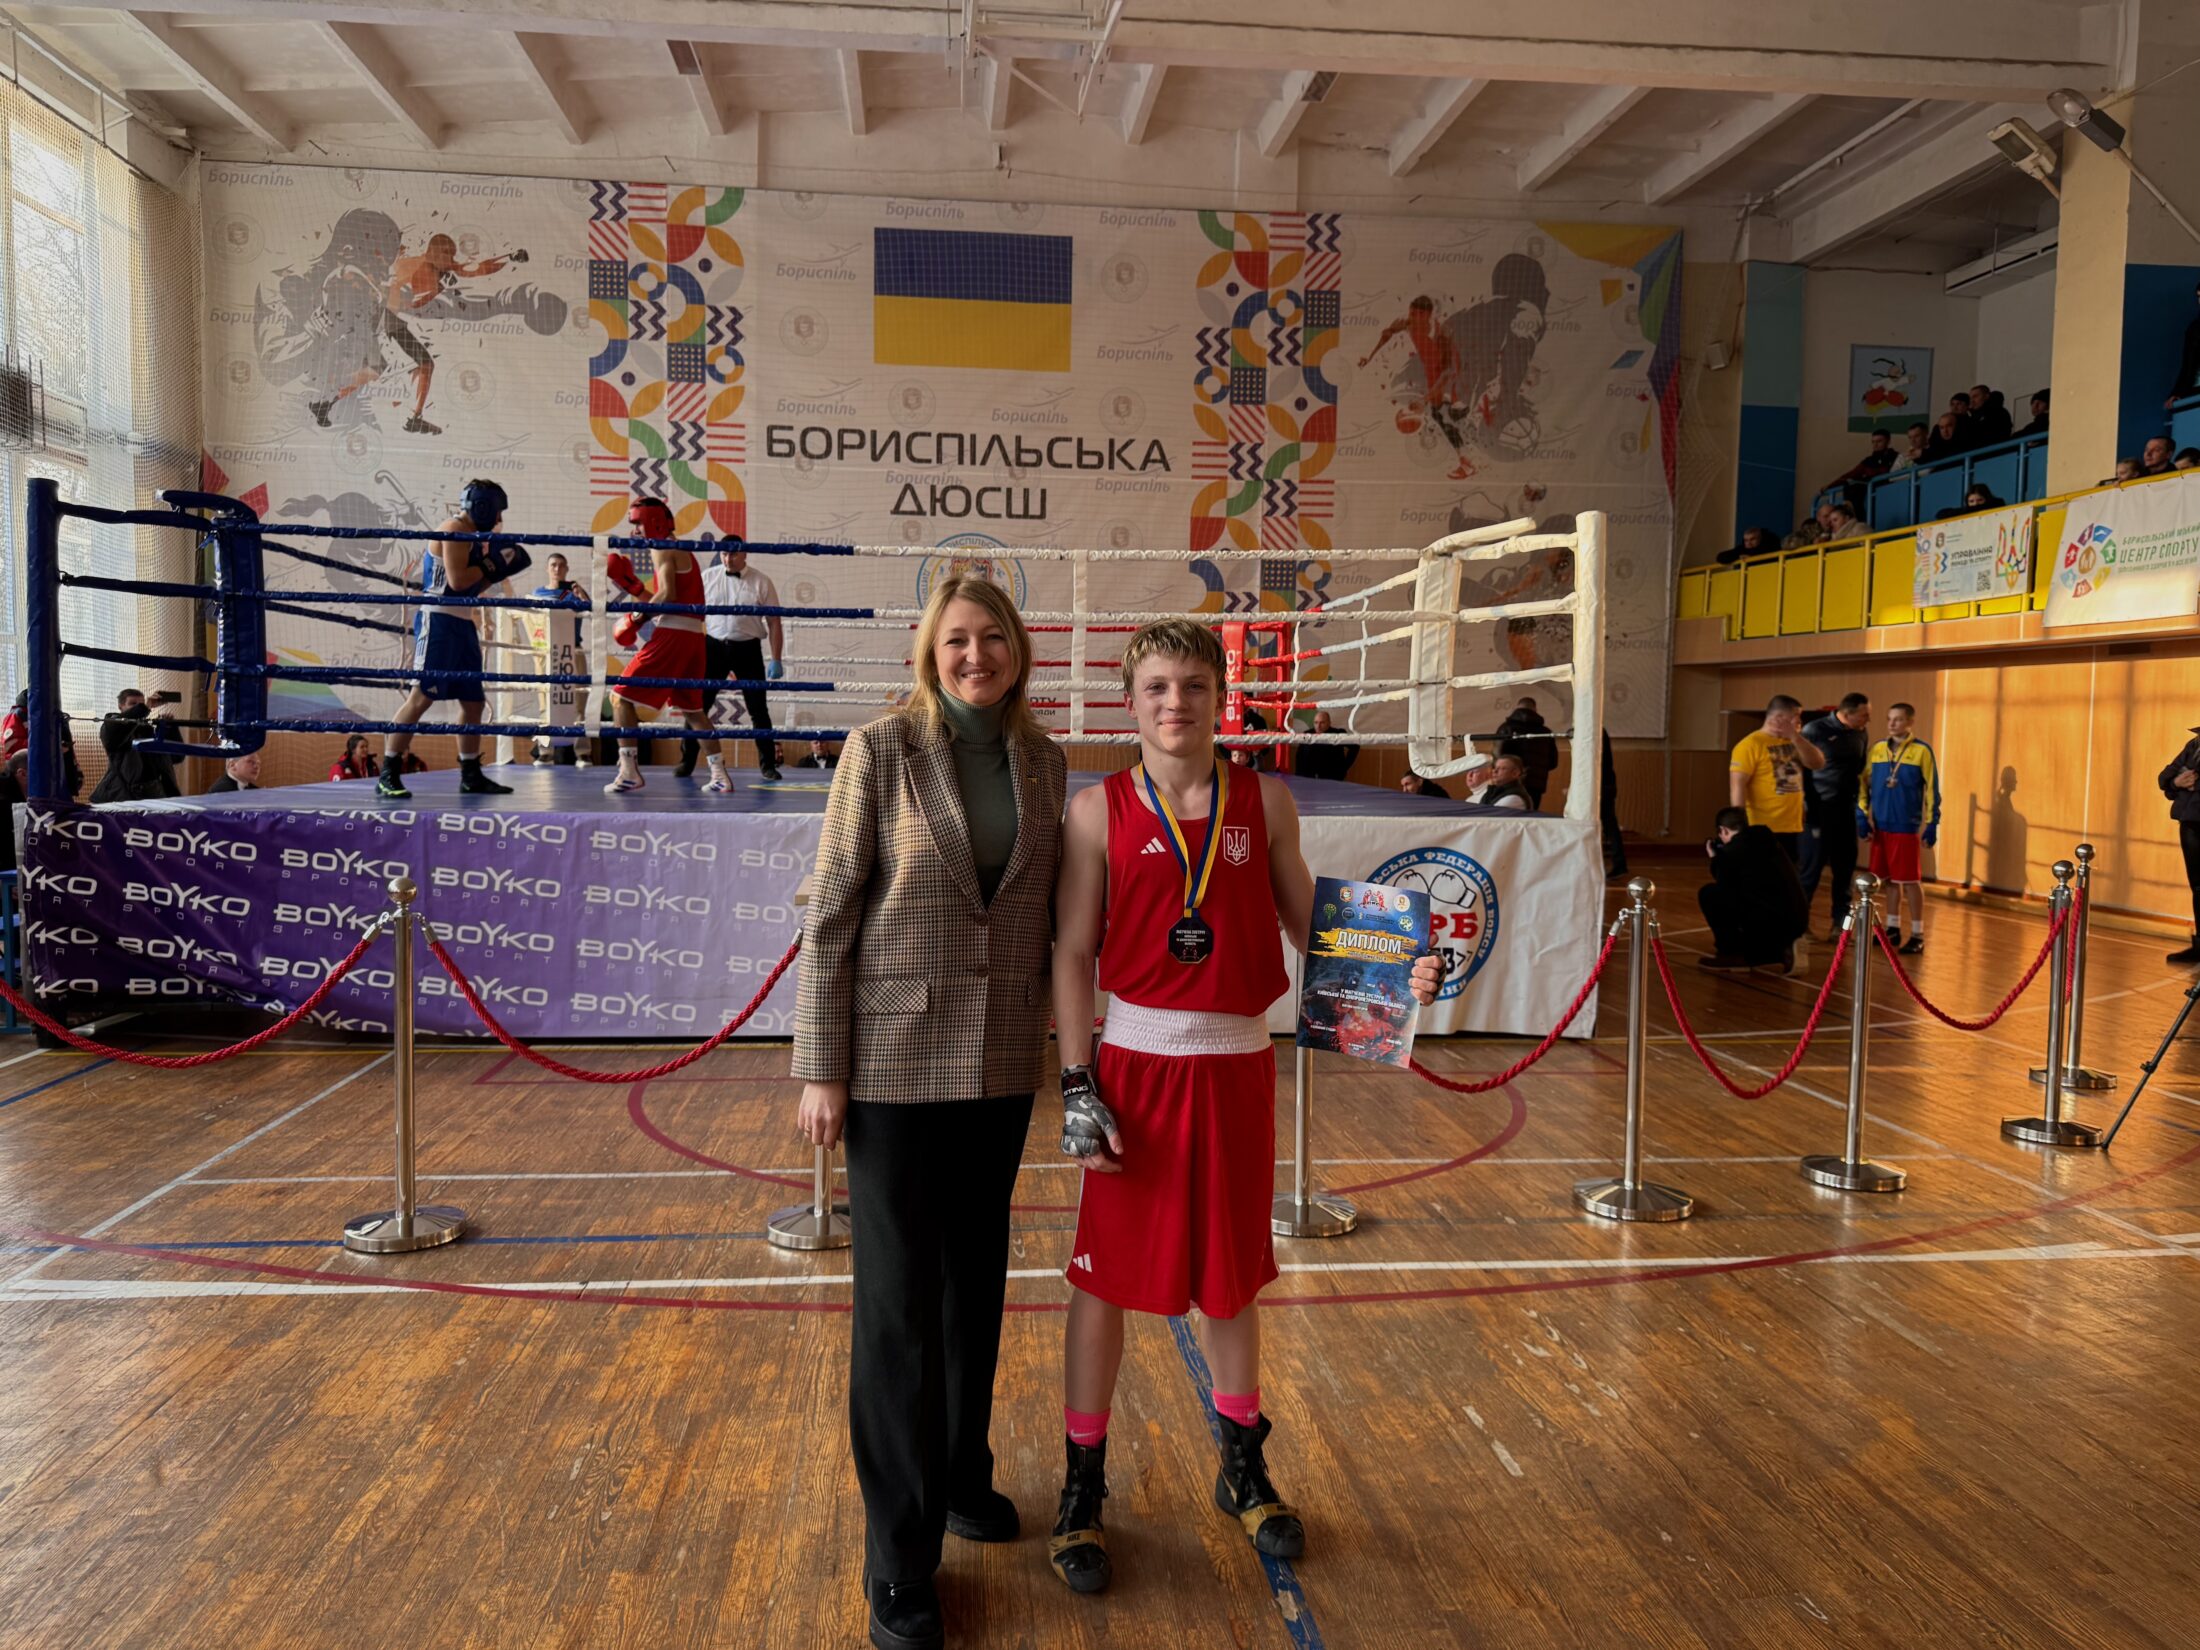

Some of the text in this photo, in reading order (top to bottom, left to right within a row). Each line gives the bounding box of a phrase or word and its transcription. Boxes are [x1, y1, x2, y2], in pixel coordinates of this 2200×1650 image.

[208, 169, 294, 187] Бориспіль
[440, 180, 523, 198] Бориспіль
[886, 202, 964, 220] Бориспіль
[1100, 210, 1176, 229] Бориспіль
[1409, 248, 1483, 265] Бориспіль
[777, 263, 856, 281] Бориспіль
[1097, 346, 1173, 362] Бориспіль
[777, 398, 856, 417] Бориспіль
[992, 407, 1068, 424] Бориспіль
[212, 447, 297, 463] Бориспіль
[766, 424, 1171, 472] БОРИСПІЛЬСЬКА
[443, 454, 525, 471] Бориспіль
[1095, 478, 1171, 494] Бориспіль
[890, 482, 1047, 520] ДЮСШ
[2119, 537, 2199, 564] ЦЕНТР СПОРТУ
[1225, 649, 1236, 721] BOKO
[437, 813, 567, 844] BOYKO
[123, 828, 257, 861] BOYKO
[589, 829, 717, 861] BOYKO
[280, 848, 409, 879] BOYKO
[739, 848, 815, 871] BOY
[282, 870, 377, 889] SPOR
[431, 866, 561, 898] BOYKO
[123, 882, 250, 916] BOYKO
[583, 884, 710, 915] BOYKO
[273, 903, 394, 935] BOYK
[577, 938, 704, 969] BOYKO
[1336, 931, 1402, 955] ДИПЛОМ
[570, 992, 697, 1022] BOYKO
